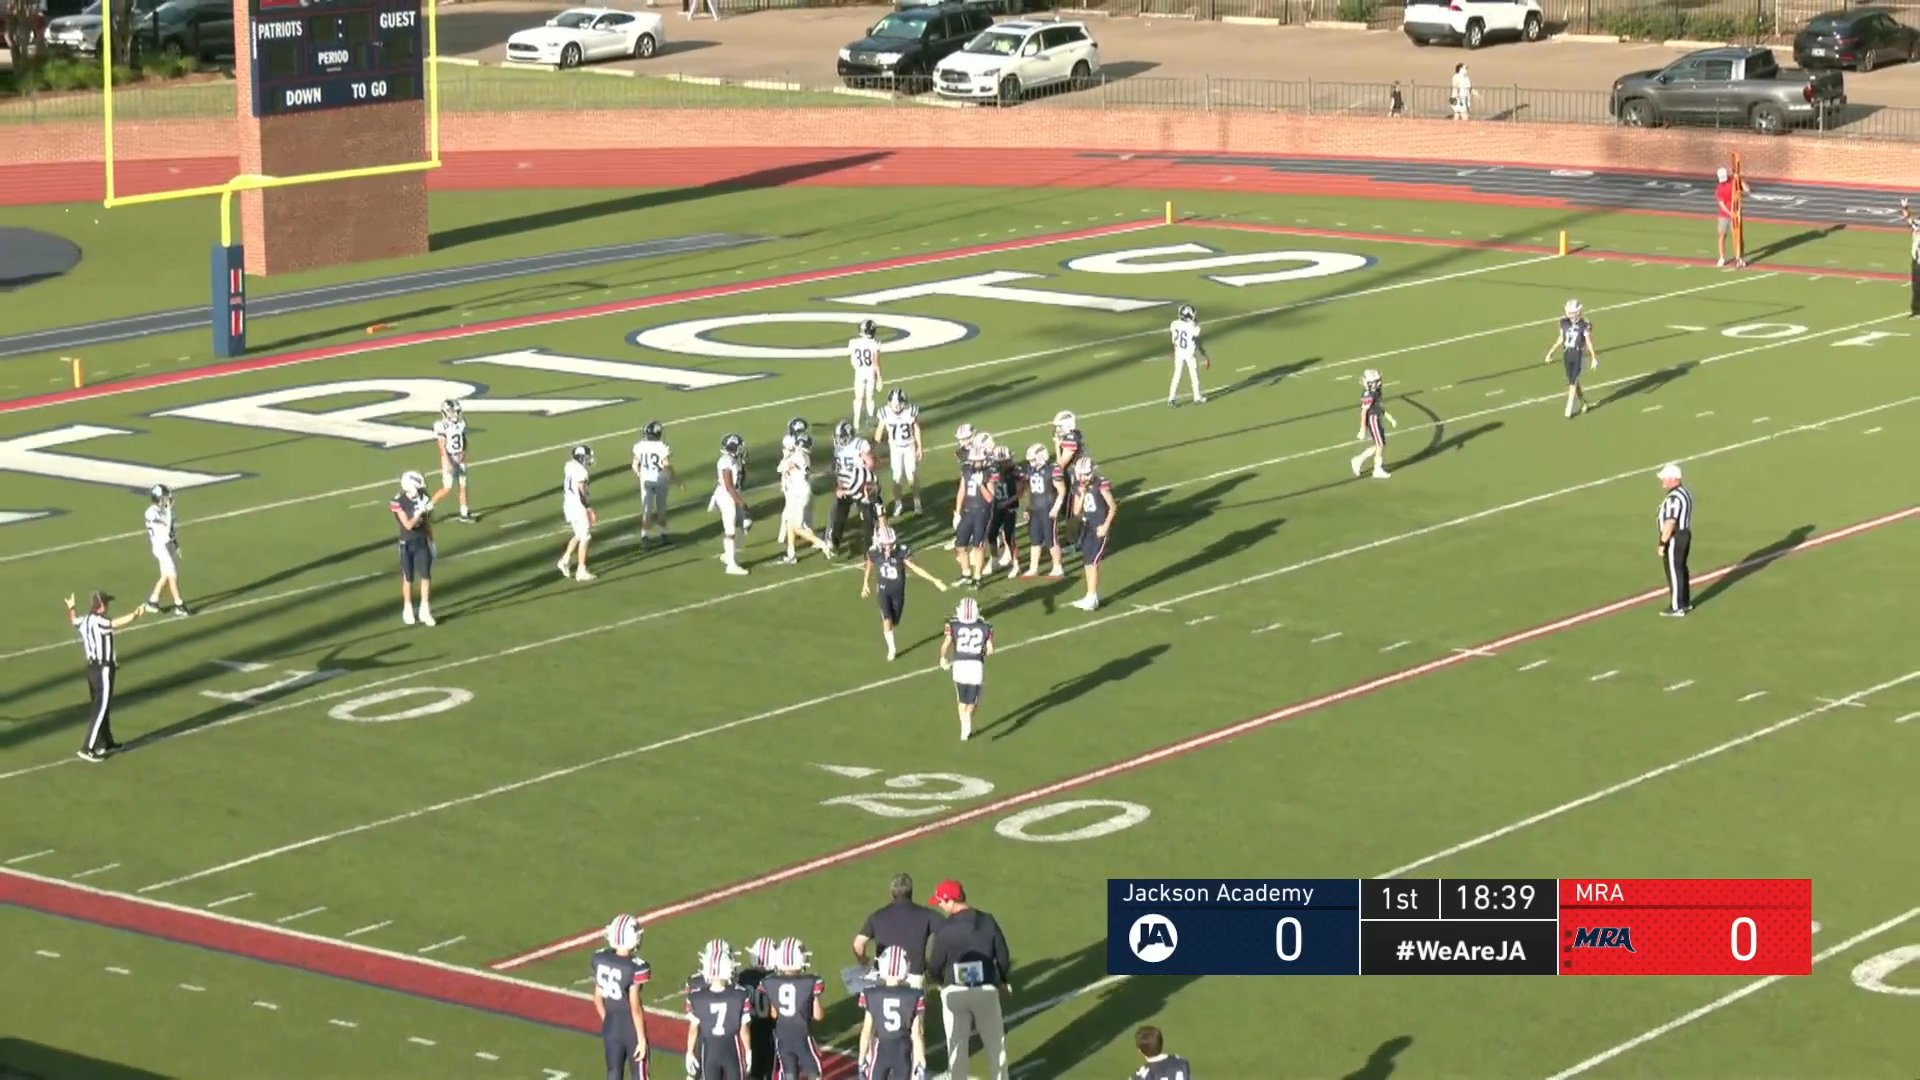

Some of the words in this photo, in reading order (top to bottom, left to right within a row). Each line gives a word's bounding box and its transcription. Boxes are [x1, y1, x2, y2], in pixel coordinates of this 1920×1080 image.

[258, 21, 303, 40] PATRIOTS
[380, 11, 416, 29] GUEST
[318, 50, 349, 65] PERIOD
[286, 87, 322, 106] DOWN
[351, 84, 366, 99] TO
[371, 80, 387, 97] GO
[0, 243, 1370, 514] TRIOTS
[889, 423, 911, 440] 73
[956, 627, 984, 655] 22
[819, 773, 1151, 842] 20
[594, 963, 622, 1001] 56
[778, 983, 797, 1017] 9
[709, 1002, 728, 1036] 7
[882, 998, 901, 1032] 5
